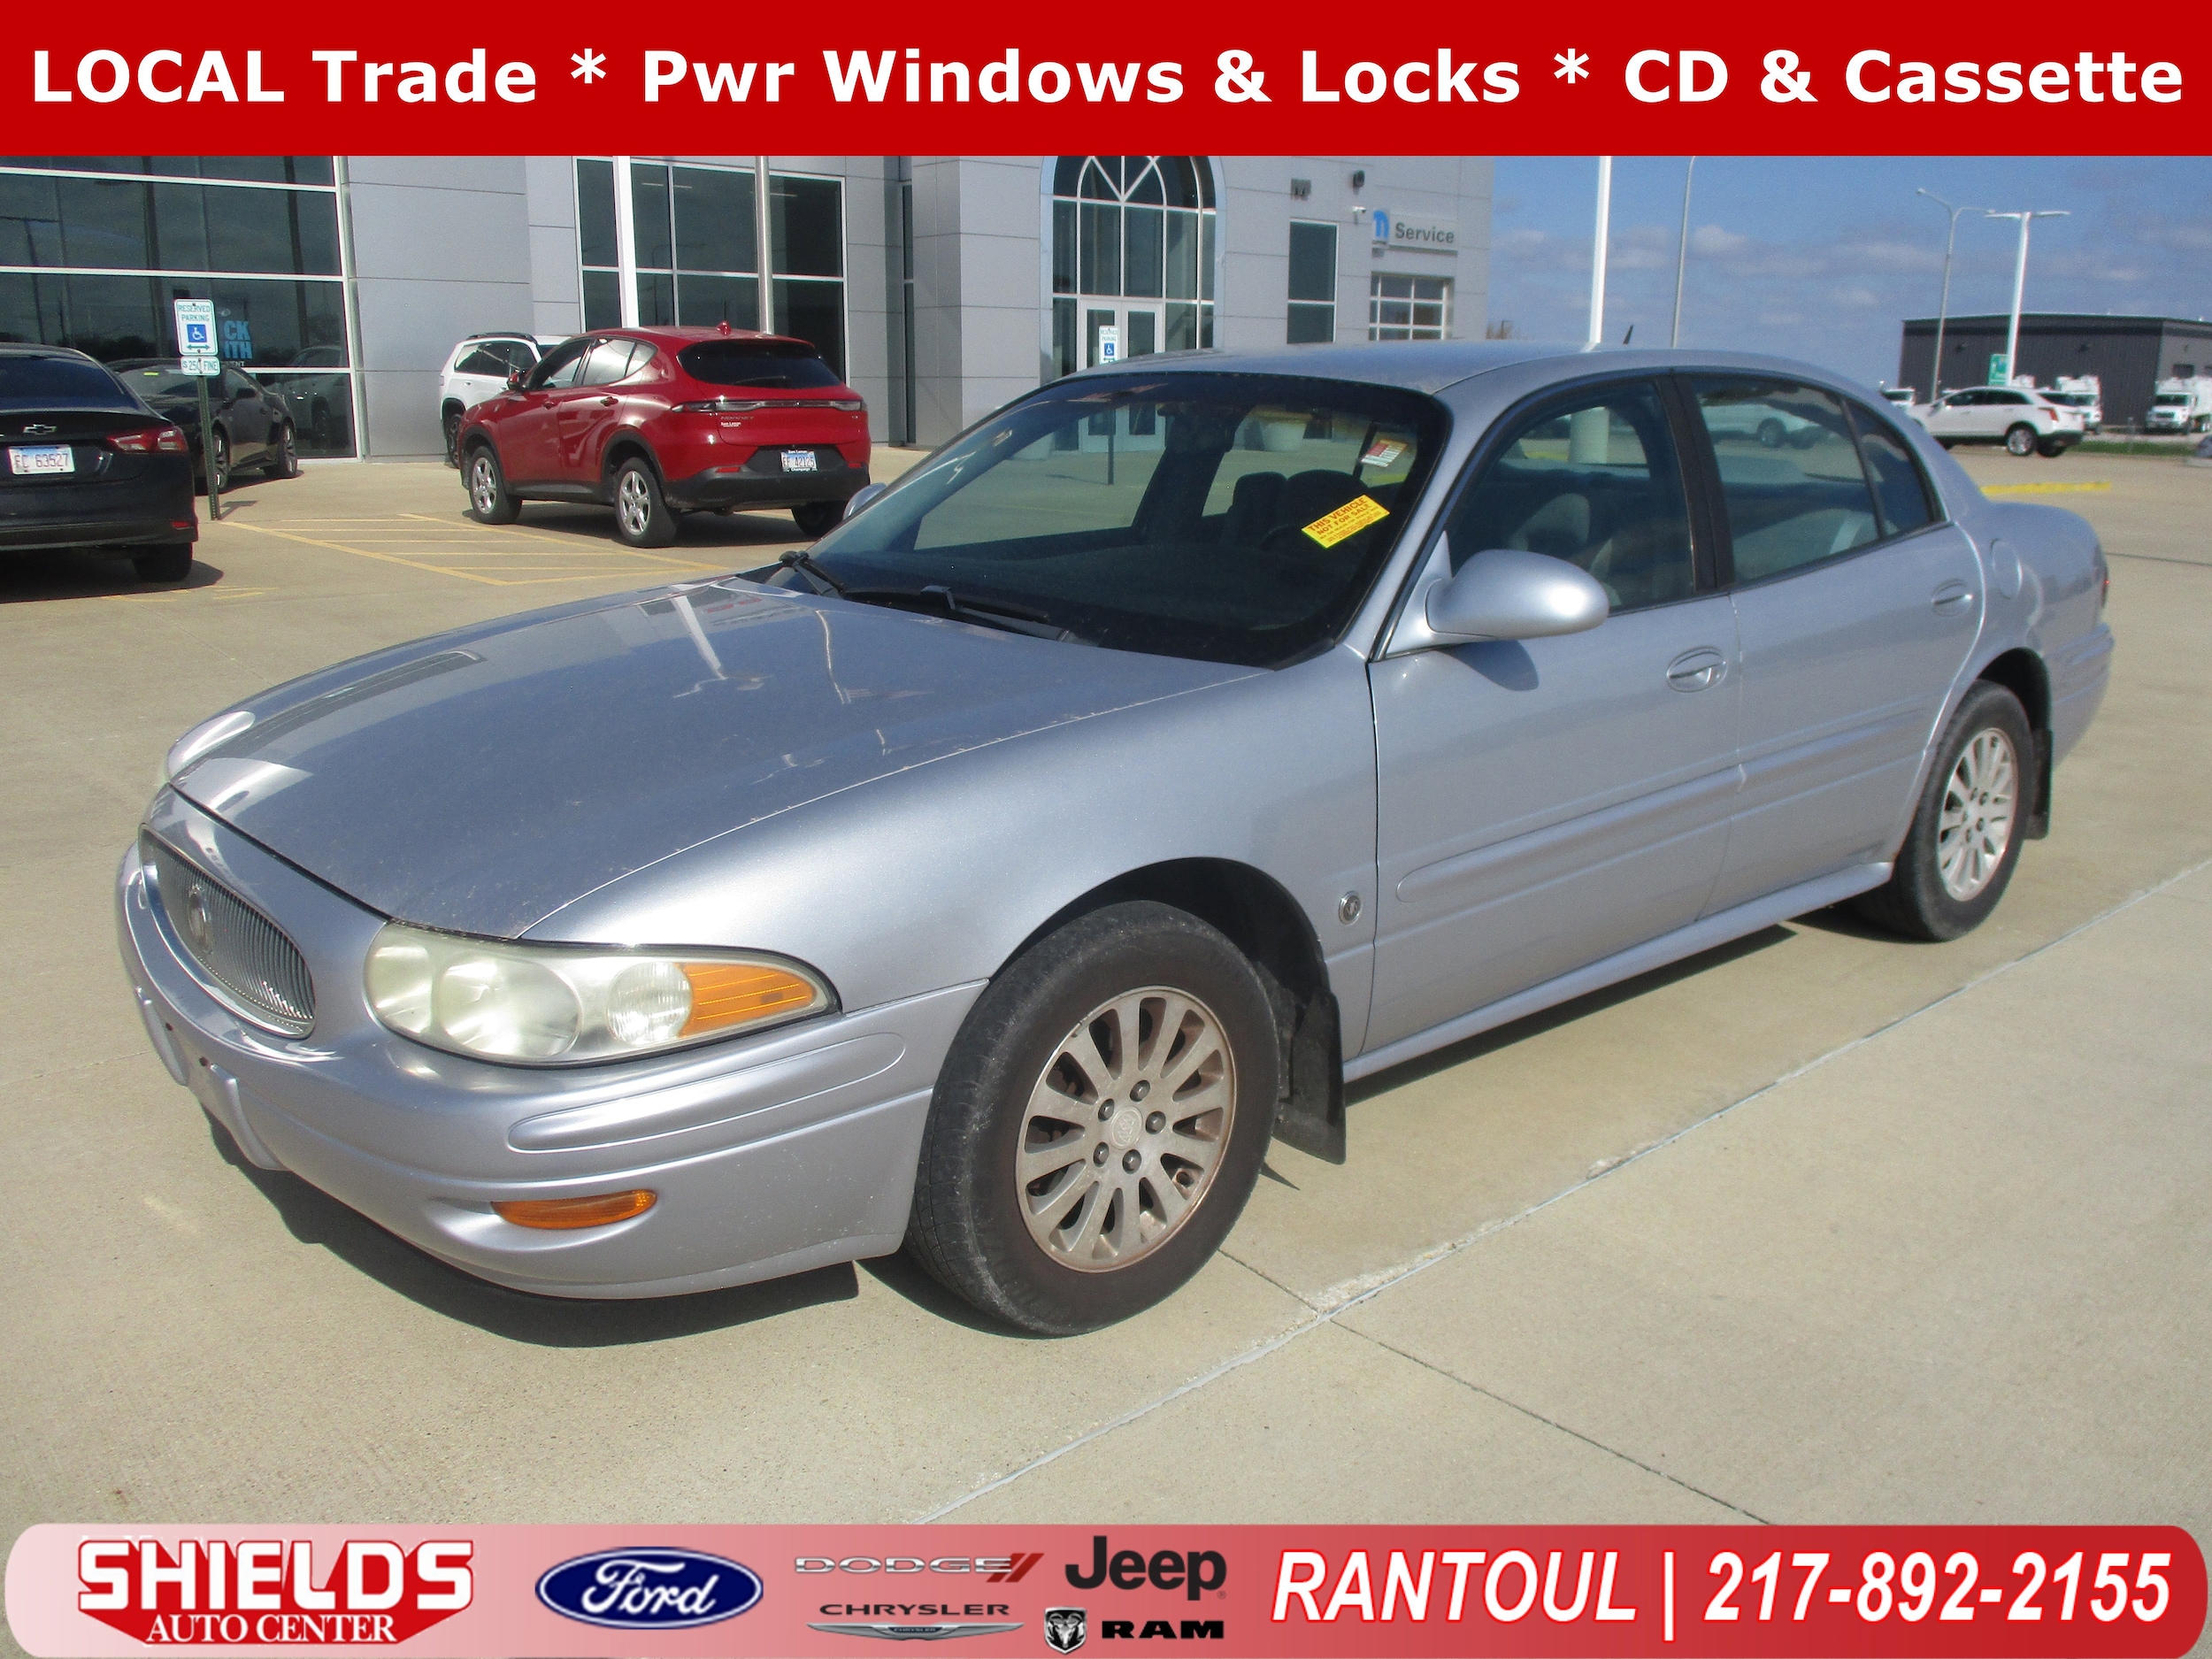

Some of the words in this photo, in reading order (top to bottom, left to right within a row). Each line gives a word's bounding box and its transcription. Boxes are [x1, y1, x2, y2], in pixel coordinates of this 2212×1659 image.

[1394, 221, 1455, 244] Service
[204, 360, 219, 372] FINE
[35, 453, 69, 467] 63527
[795, 456, 815, 467] 42125
[1308, 518, 1331, 532] THIS
[1329, 496, 1368, 520] VEHICLE
[1317, 523, 1333, 535] NOT
[1333, 514, 1352, 526] FOR
[1351, 503, 1371, 516] SALE
